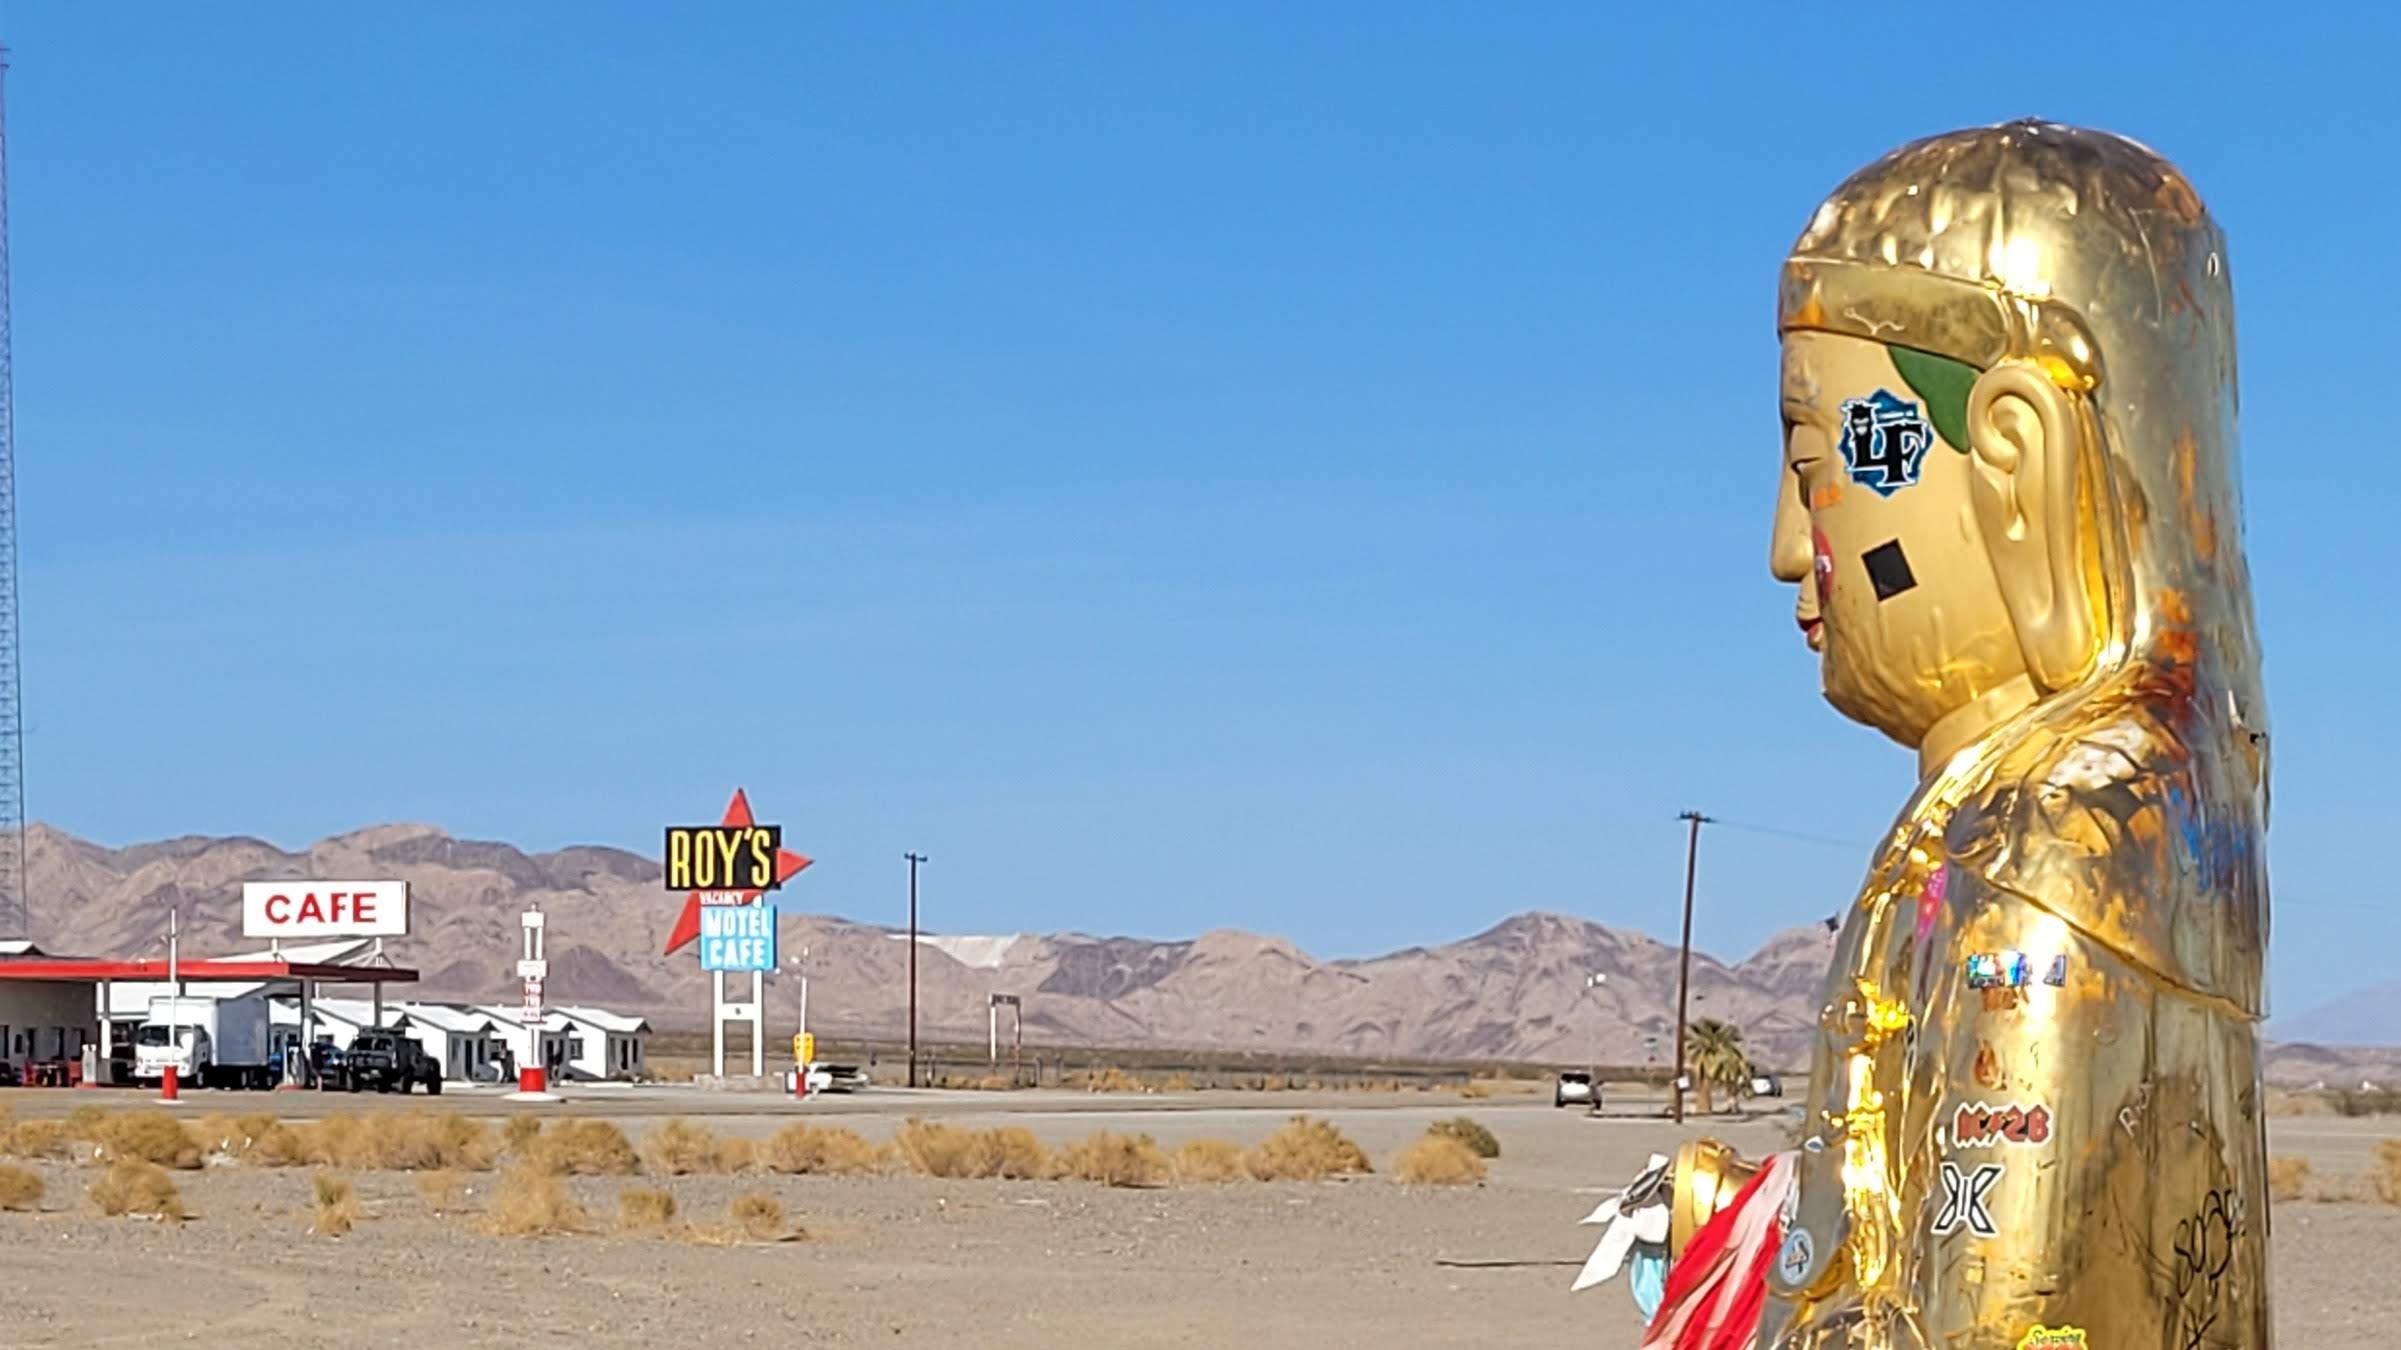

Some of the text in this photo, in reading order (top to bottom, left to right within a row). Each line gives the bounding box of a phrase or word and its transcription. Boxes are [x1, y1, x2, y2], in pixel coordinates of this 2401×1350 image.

[669, 827, 771, 887] ROY'S
[265, 893, 377, 924] CAFE
[705, 908, 770, 937] MOTEL
[709, 938, 766, 967] CAFE
